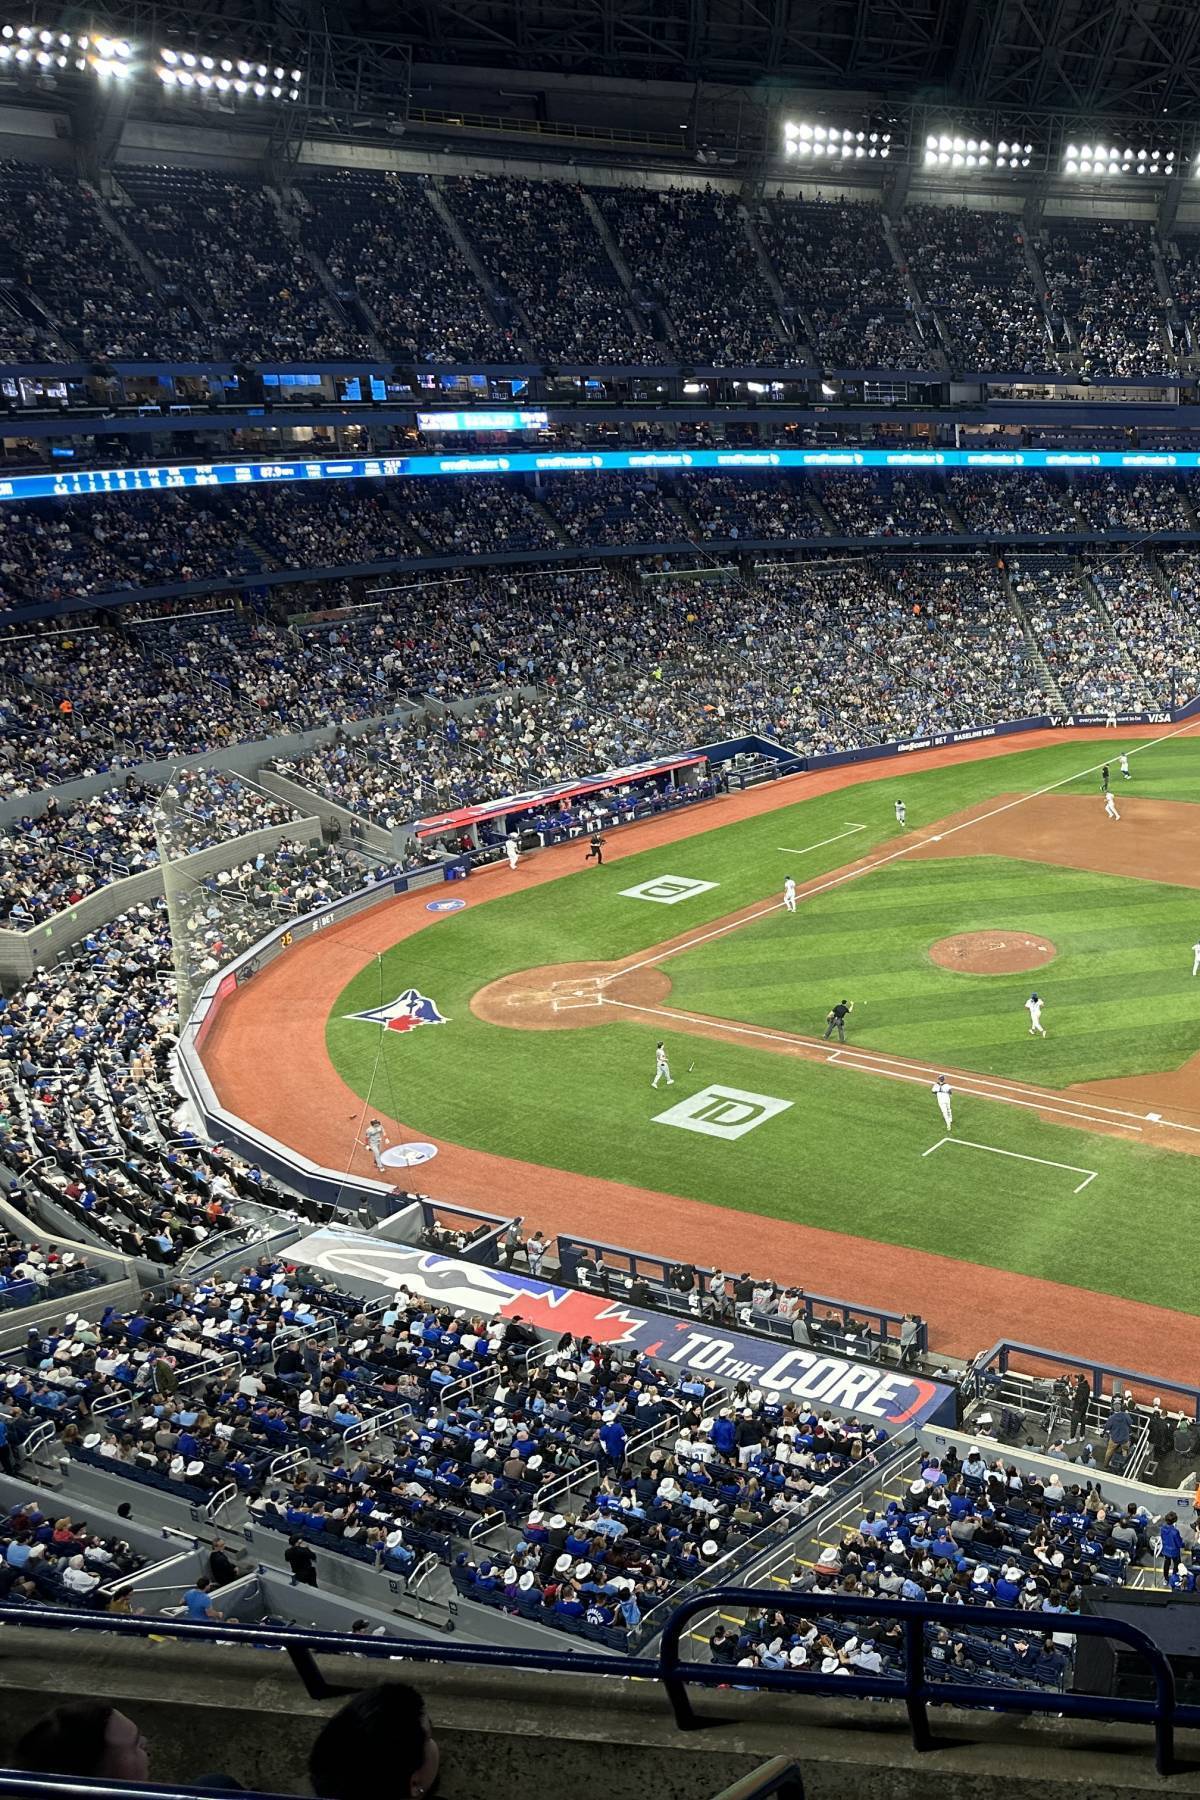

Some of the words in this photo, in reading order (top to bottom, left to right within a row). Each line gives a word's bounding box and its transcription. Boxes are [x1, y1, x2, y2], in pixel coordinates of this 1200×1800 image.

[1049, 716, 1075, 726] VA
[1147, 713, 1172, 723] VISA
[934, 736, 948, 745] BET
[953, 730, 983, 741] BASELINE
[982, 728, 996, 736] BOX
[321, 913, 335, 926] BET
[688, 1093, 766, 1127] TD
[668, 1333, 735, 1371] TO
[714, 1358, 764, 1383] THE
[757, 1350, 916, 1418] CORE
